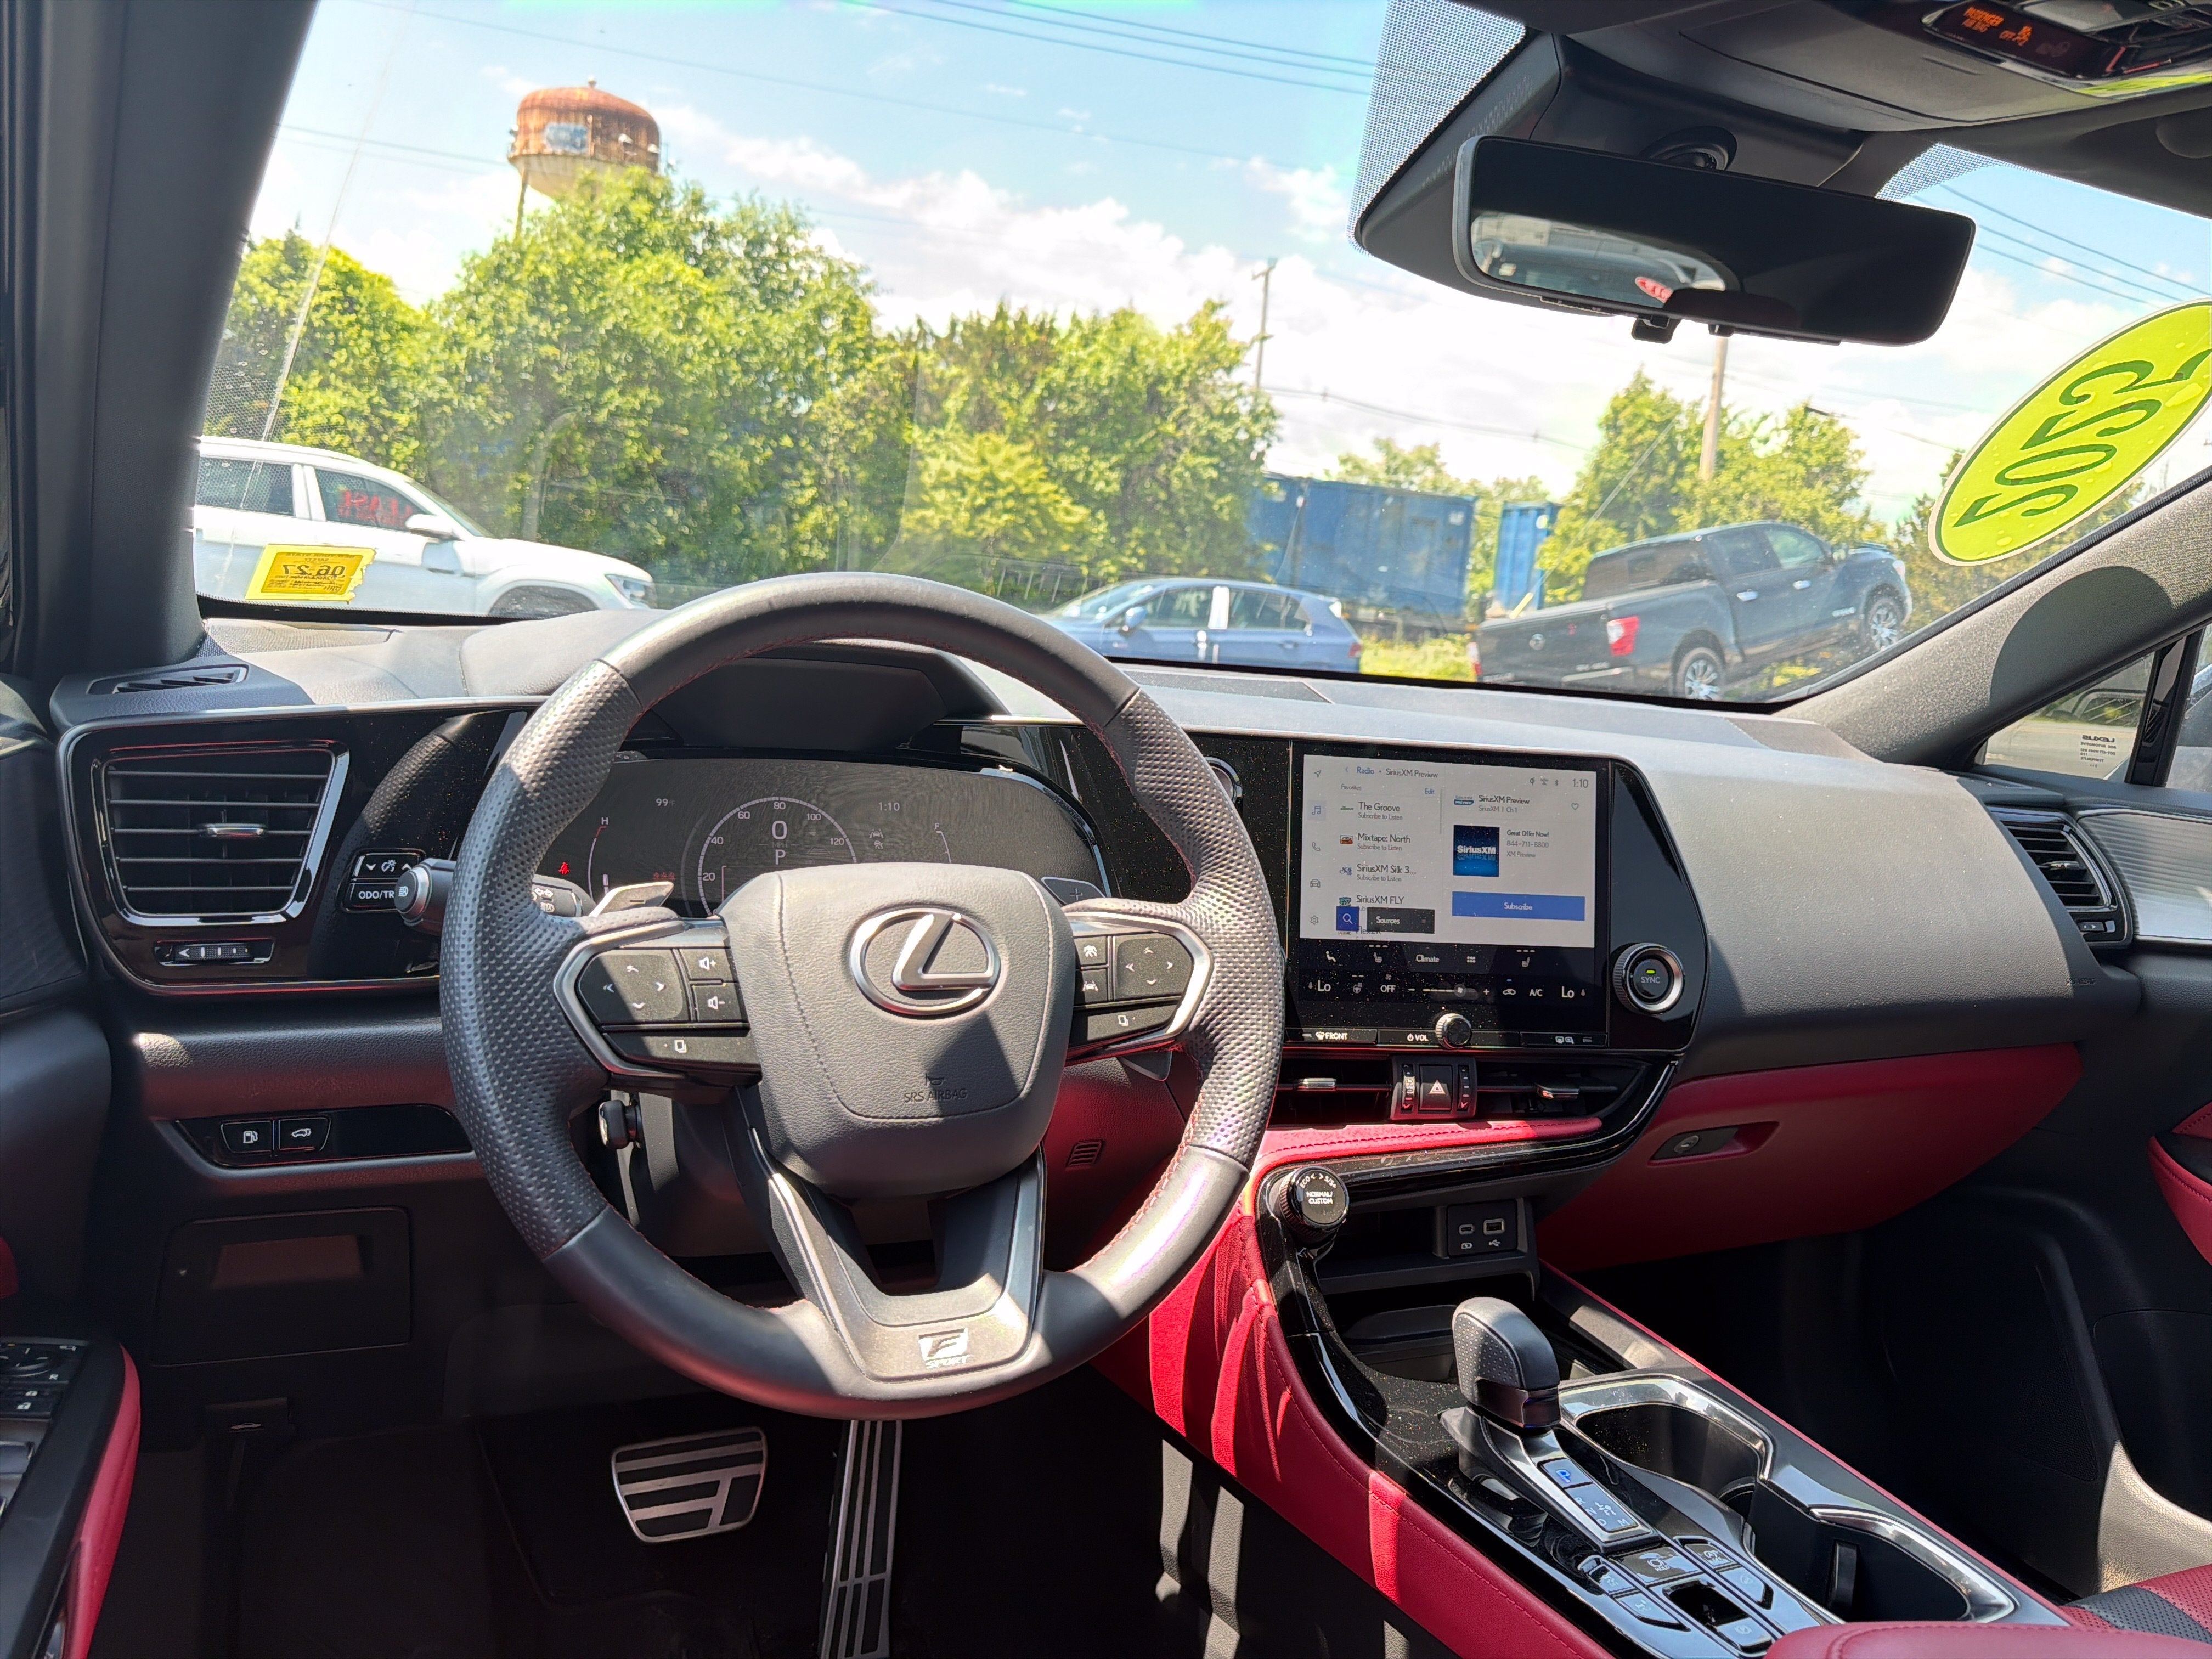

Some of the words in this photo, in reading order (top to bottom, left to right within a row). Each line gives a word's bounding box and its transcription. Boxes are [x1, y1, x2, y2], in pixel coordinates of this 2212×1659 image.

[1386, 768, 1413, 777] SiriusXM
[1414, 770, 1438, 778] Preview
[1572, 779, 1589, 788] 1:10
[1479, 795, 1505, 803] SiriusXM
[1506, 796, 1530, 804] Preview
[774, 802, 786, 810] 80
[878, 802, 900, 811] 1:10
[1358, 802, 1372, 810] The
[1374, 803, 1401, 812] Groove
[738, 811, 751, 820] 60
[806, 812, 821, 821] 100
[601, 817, 608, 825] H
[710, 837, 724, 845] 40
[1358, 833, 1387, 843] Mixtape:
[1390, 834, 1410, 843] North
[1457, 845, 1496, 855] SiriusXM
[775, 850, 786, 865] P
[1357, 864, 1388, 873] SiriusXM
[1390, 865, 1402, 873] Silk
[1404, 866, 1417, 874] 3...
[703, 873, 715, 881] 20
[1356, 895, 1387, 904] SiriusXM
[1390, 895, 1404, 905] FLY
[1504, 902, 1533, 910] Subscribe
[1376, 916, 1400, 924] Sources
[1415, 954, 1440, 963] Climate
[1318, 979, 1331, 992] Lo
[1380, 985, 1396, 993] OFF
[1529, 988, 1543, 997] A/C
[1561, 986, 1575, 998] Lo
[905, 1091, 924, 1103] SRS
[928, 1088, 968, 1101] AIRBAG
[1300, 1176, 1311, 1189] ECO
[925, 1354, 970, 1369] SPORT
[1555, 1469, 1571, 1483] P
[1617, 1518, 1630, 1527] M
